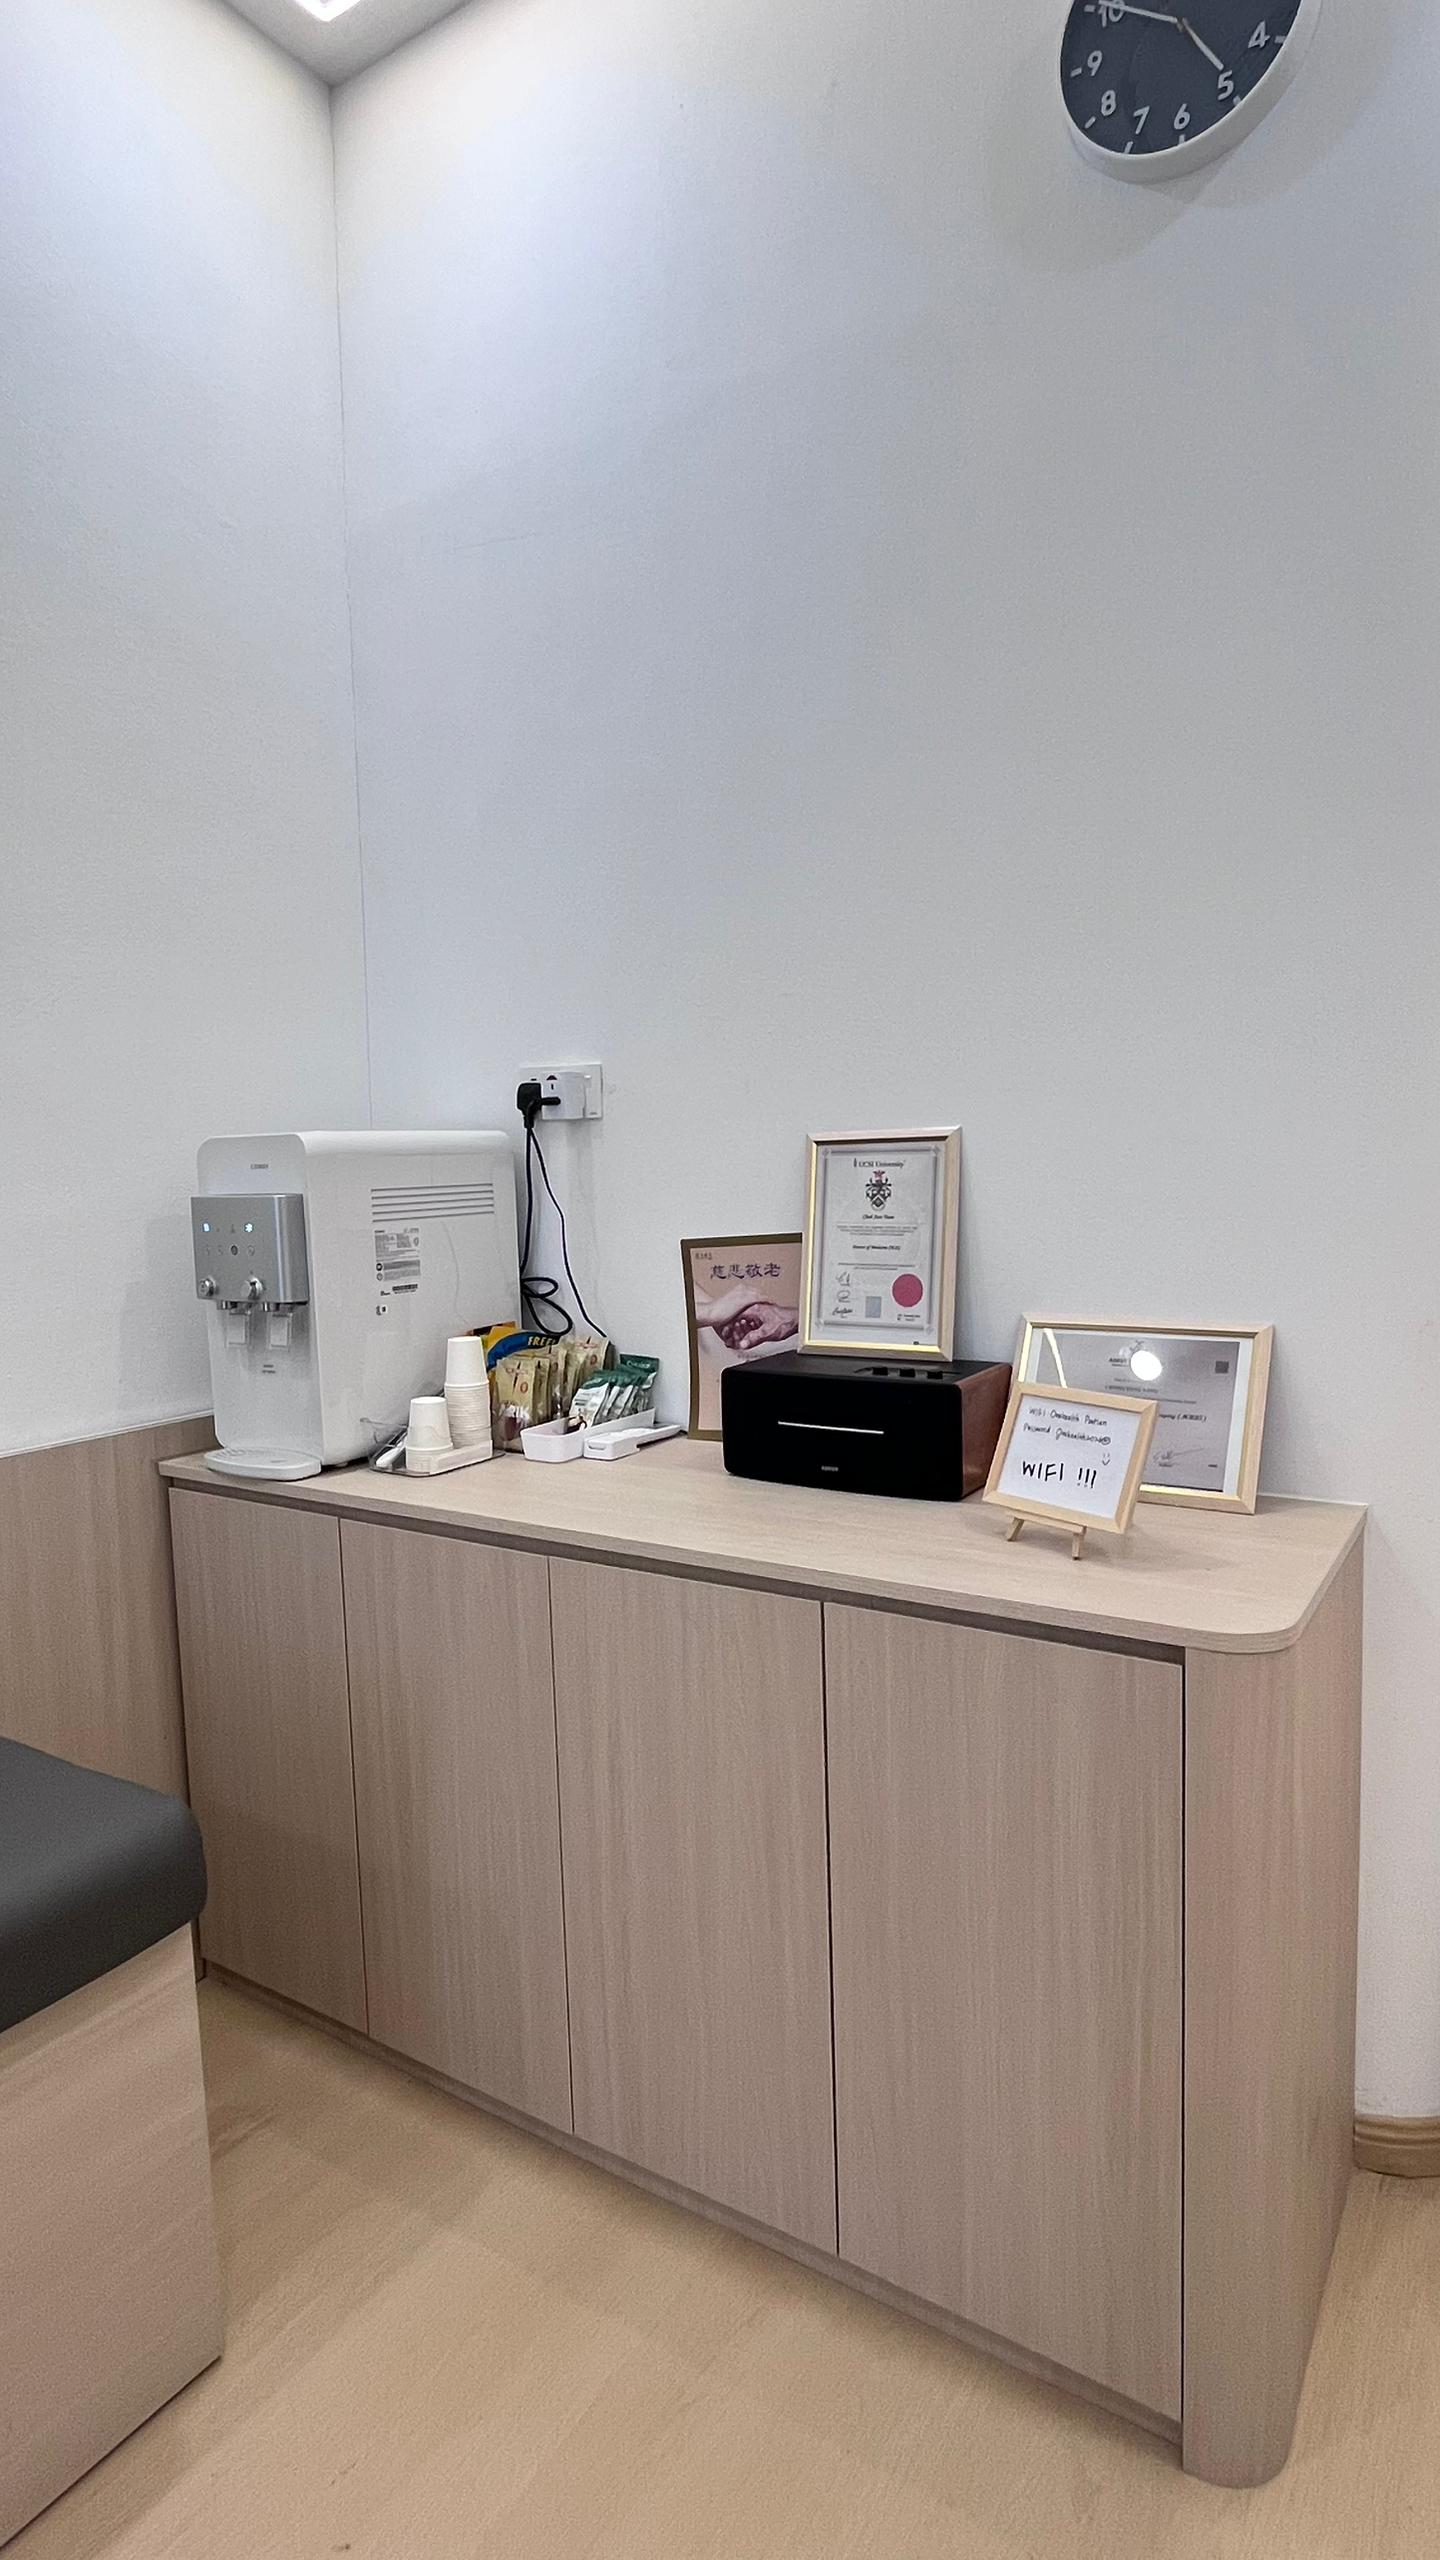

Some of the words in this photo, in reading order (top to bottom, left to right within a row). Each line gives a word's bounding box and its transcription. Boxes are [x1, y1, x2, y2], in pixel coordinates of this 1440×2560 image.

[1247, 20, 1271, 49] 4
[1086, 50, 1103, 77] 9
[1217, 69, 1235, 101] 5
[1100, 89, 1117, 117] 8
[1173, 103, 1191, 130] 6
[1132, 105, 1151, 135] 7
[710, 1262, 781, 1280] 慈悲敬老
[1022, 1460, 1064, 1482] WIFI
[1077, 1467, 1097, 1489] !!!
